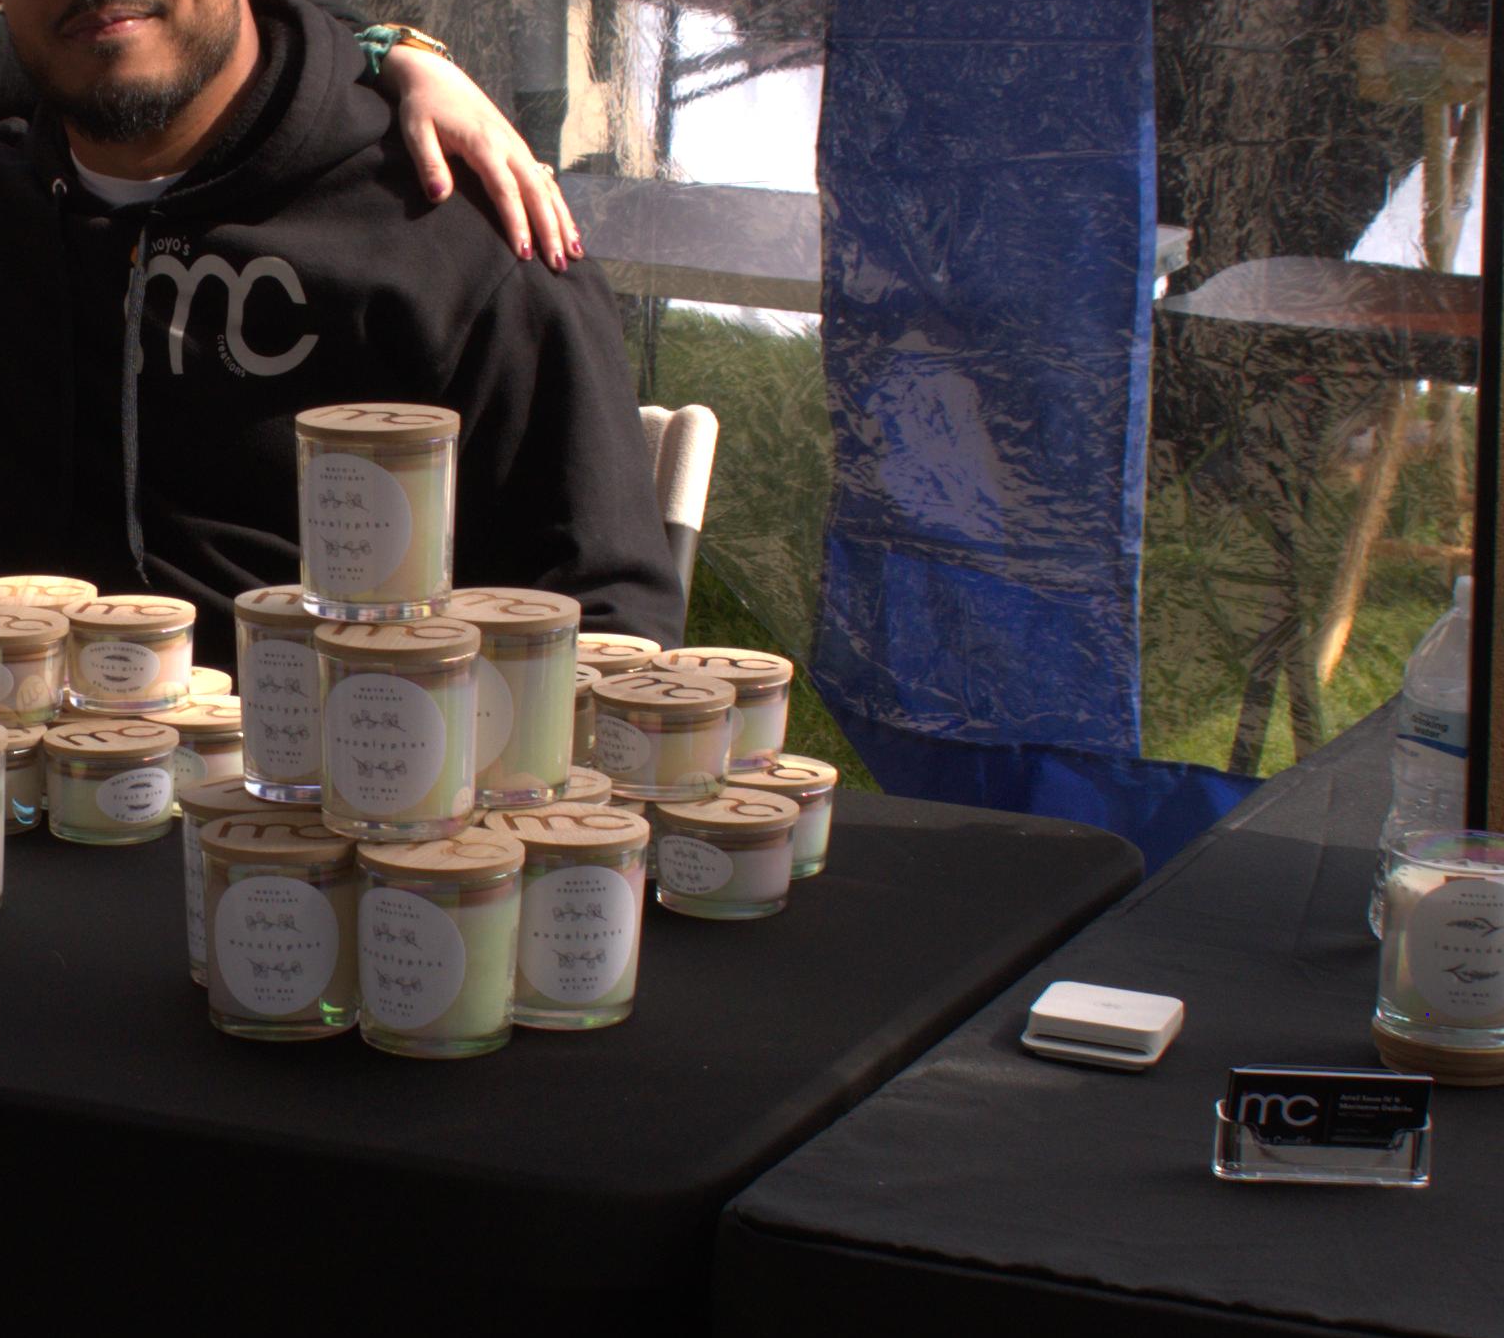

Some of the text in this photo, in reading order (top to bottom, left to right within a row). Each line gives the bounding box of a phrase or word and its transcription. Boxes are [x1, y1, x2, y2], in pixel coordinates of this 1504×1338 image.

[314, 406, 444, 426] mc
[77, 601, 182, 616] mc
[333, 620, 467, 640] mc
[670, 652, 780, 671] mc
[610, 674, 715, 701] mc
[56, 724, 166, 747] mc
[502, 812, 635, 832] mc
[1238, 1092, 1320, 1127] mc
